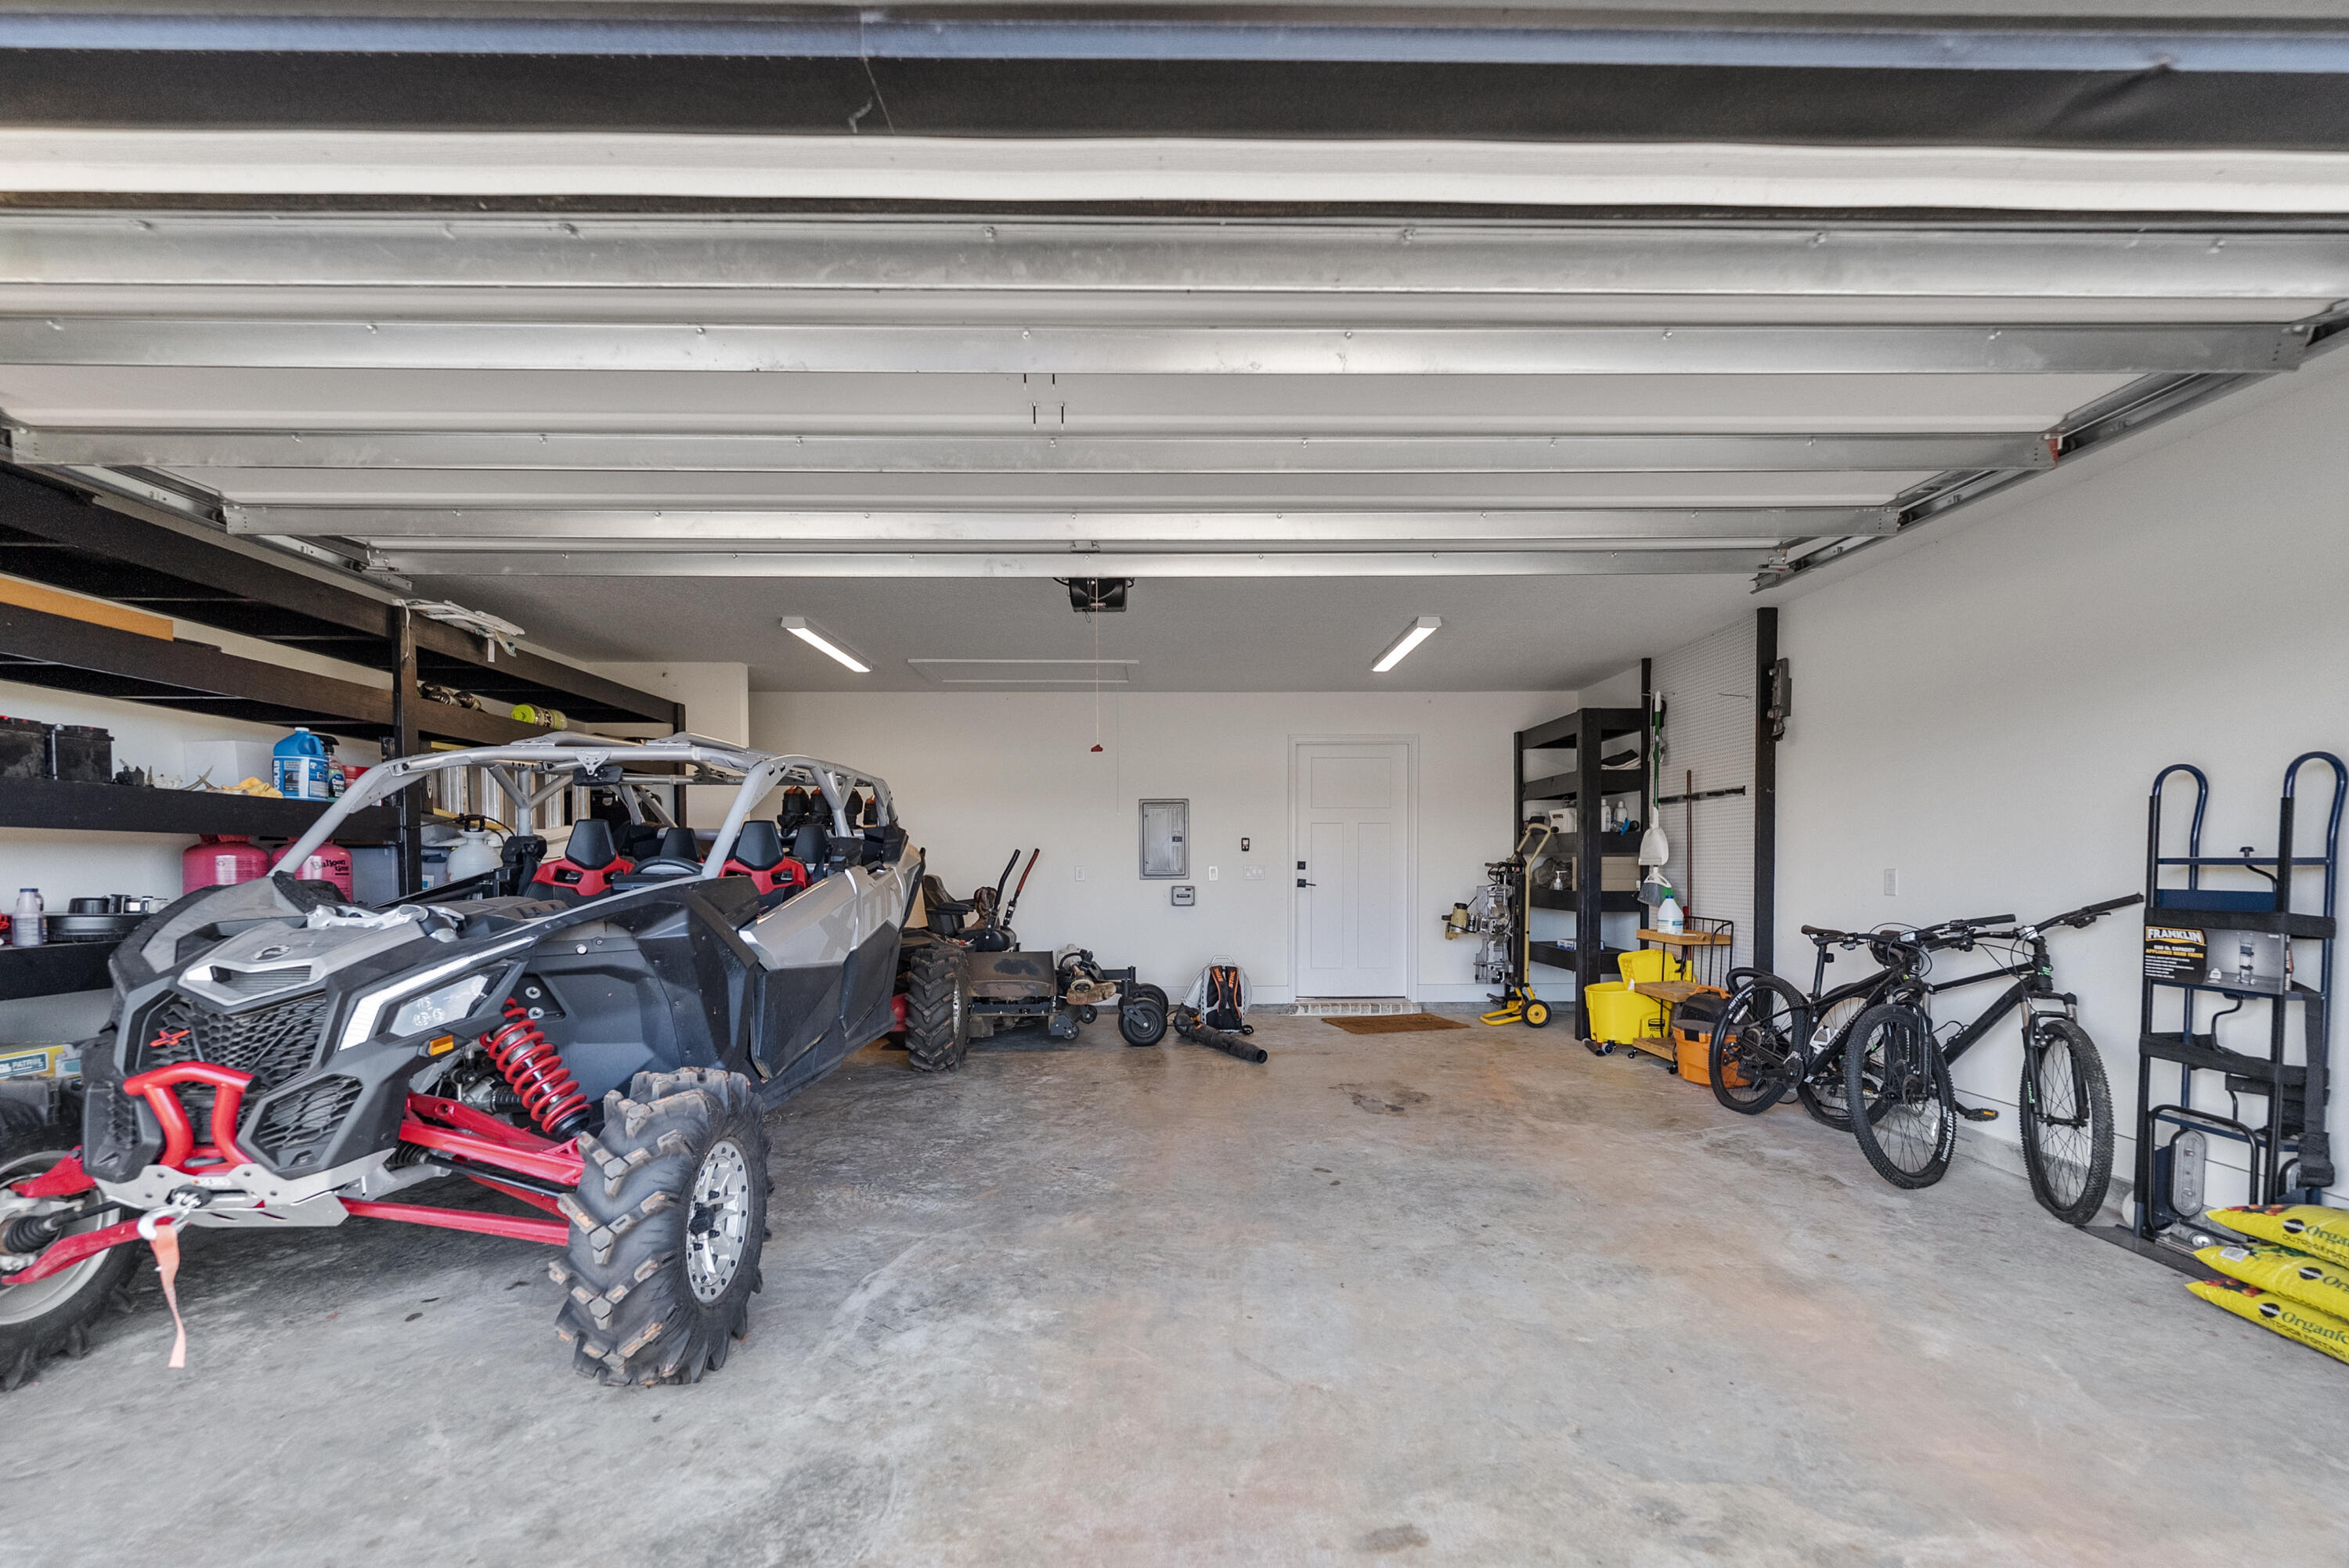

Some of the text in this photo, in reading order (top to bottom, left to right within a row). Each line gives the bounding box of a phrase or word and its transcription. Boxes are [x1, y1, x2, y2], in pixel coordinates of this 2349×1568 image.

[311, 859, 345, 871] Balloon
[2148, 928, 2203, 943] FRANKLIN
[1824, 1001, 1867, 1051] cannondale
[2306, 1226, 2349, 1248] Orga
